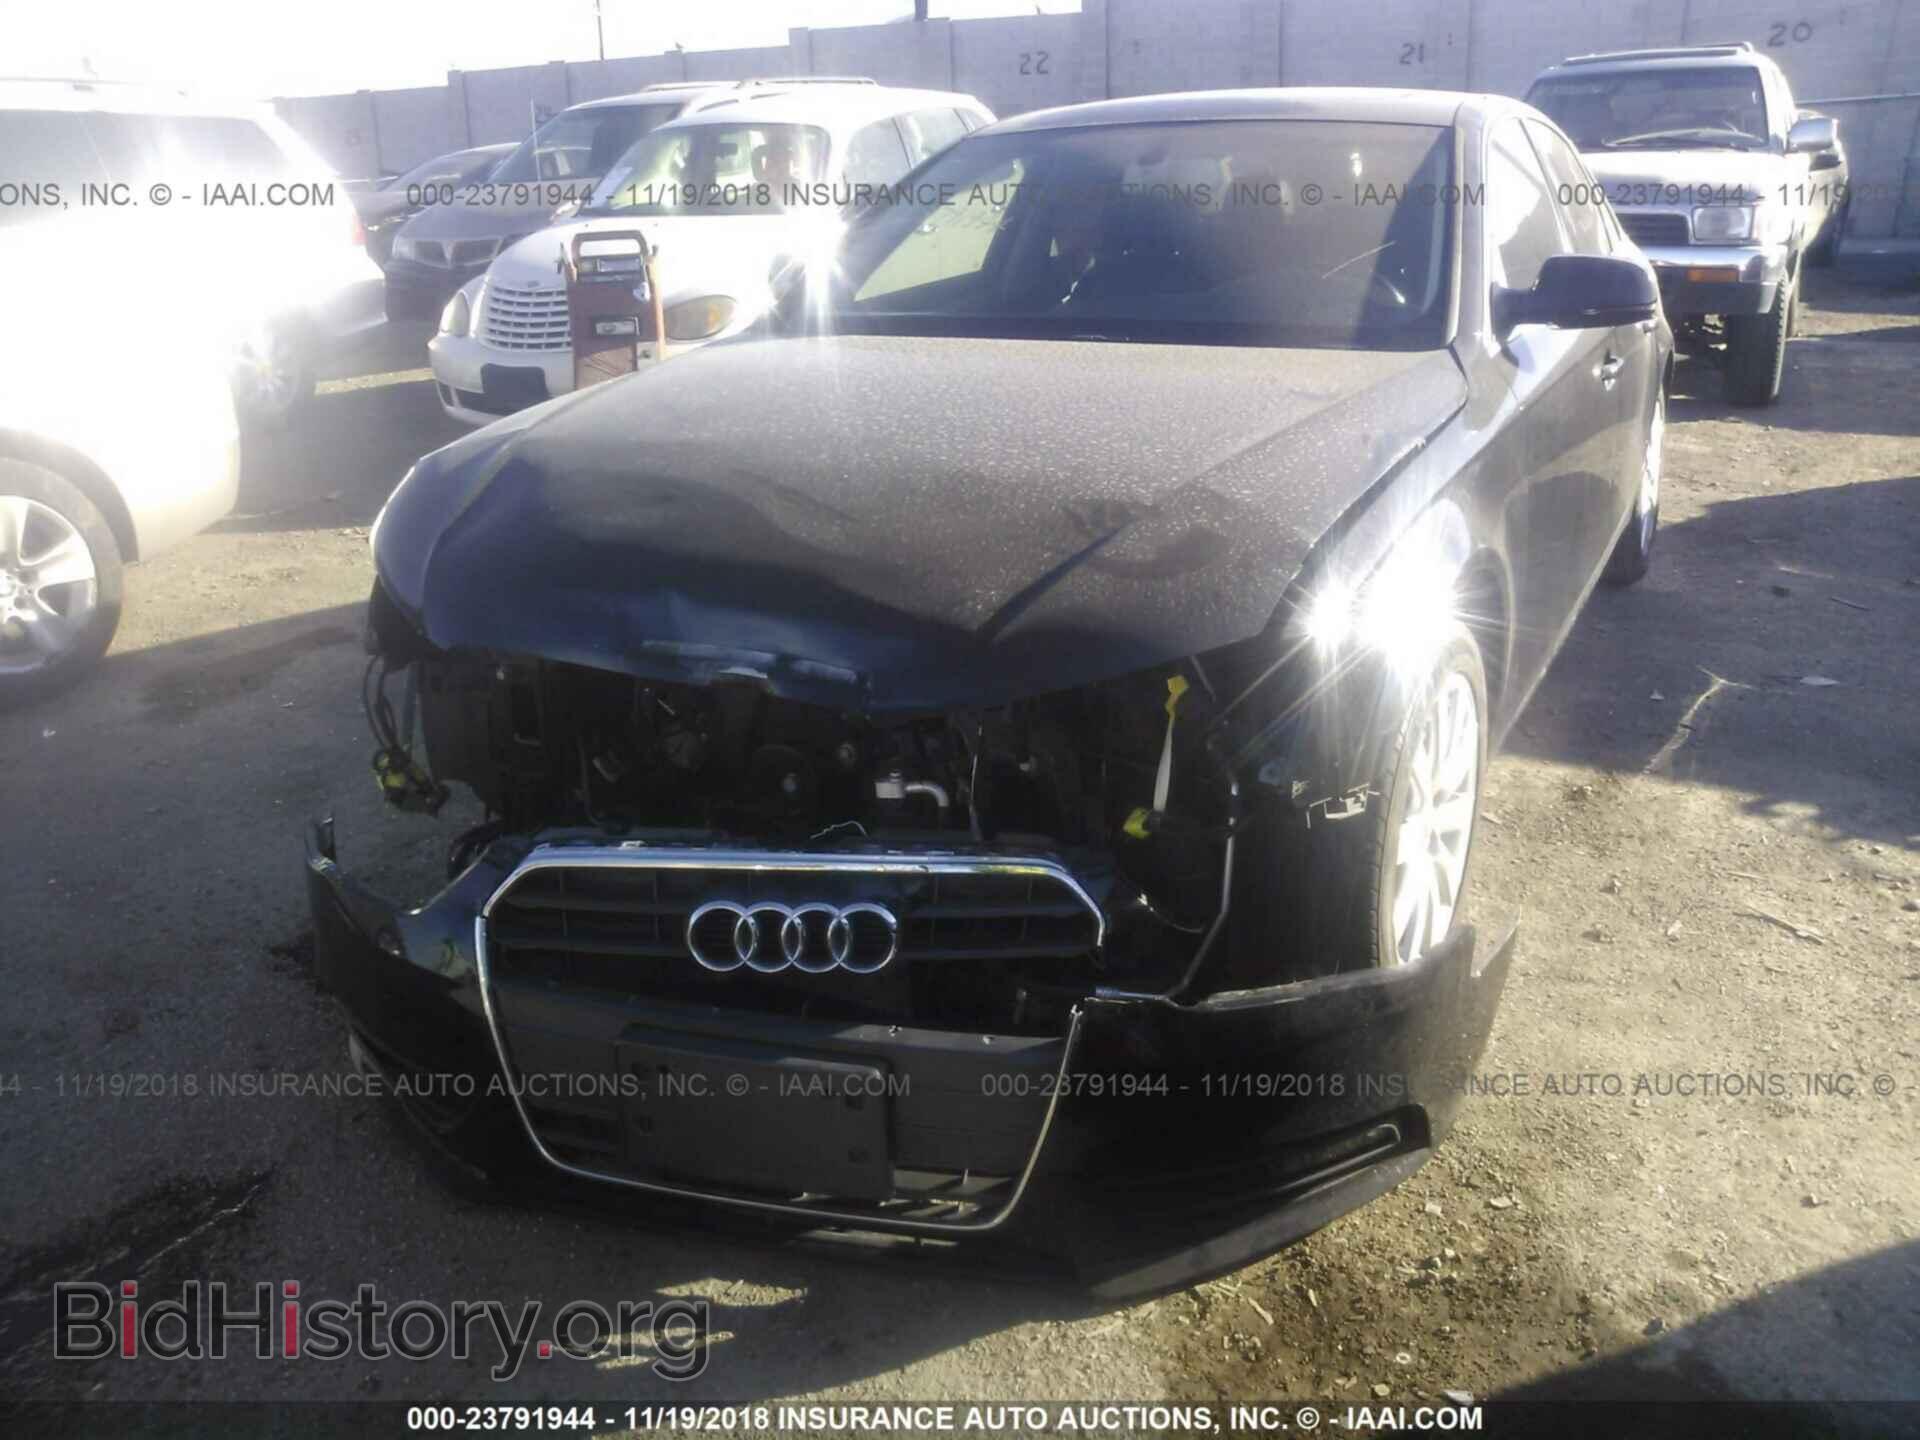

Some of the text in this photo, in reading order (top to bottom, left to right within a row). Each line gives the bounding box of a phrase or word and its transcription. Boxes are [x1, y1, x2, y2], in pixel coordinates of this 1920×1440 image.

[1766, 21, 1814, 48] 20
[1019, 50, 1049, 75] 22
[1399, 42, 1425, 66] 21
